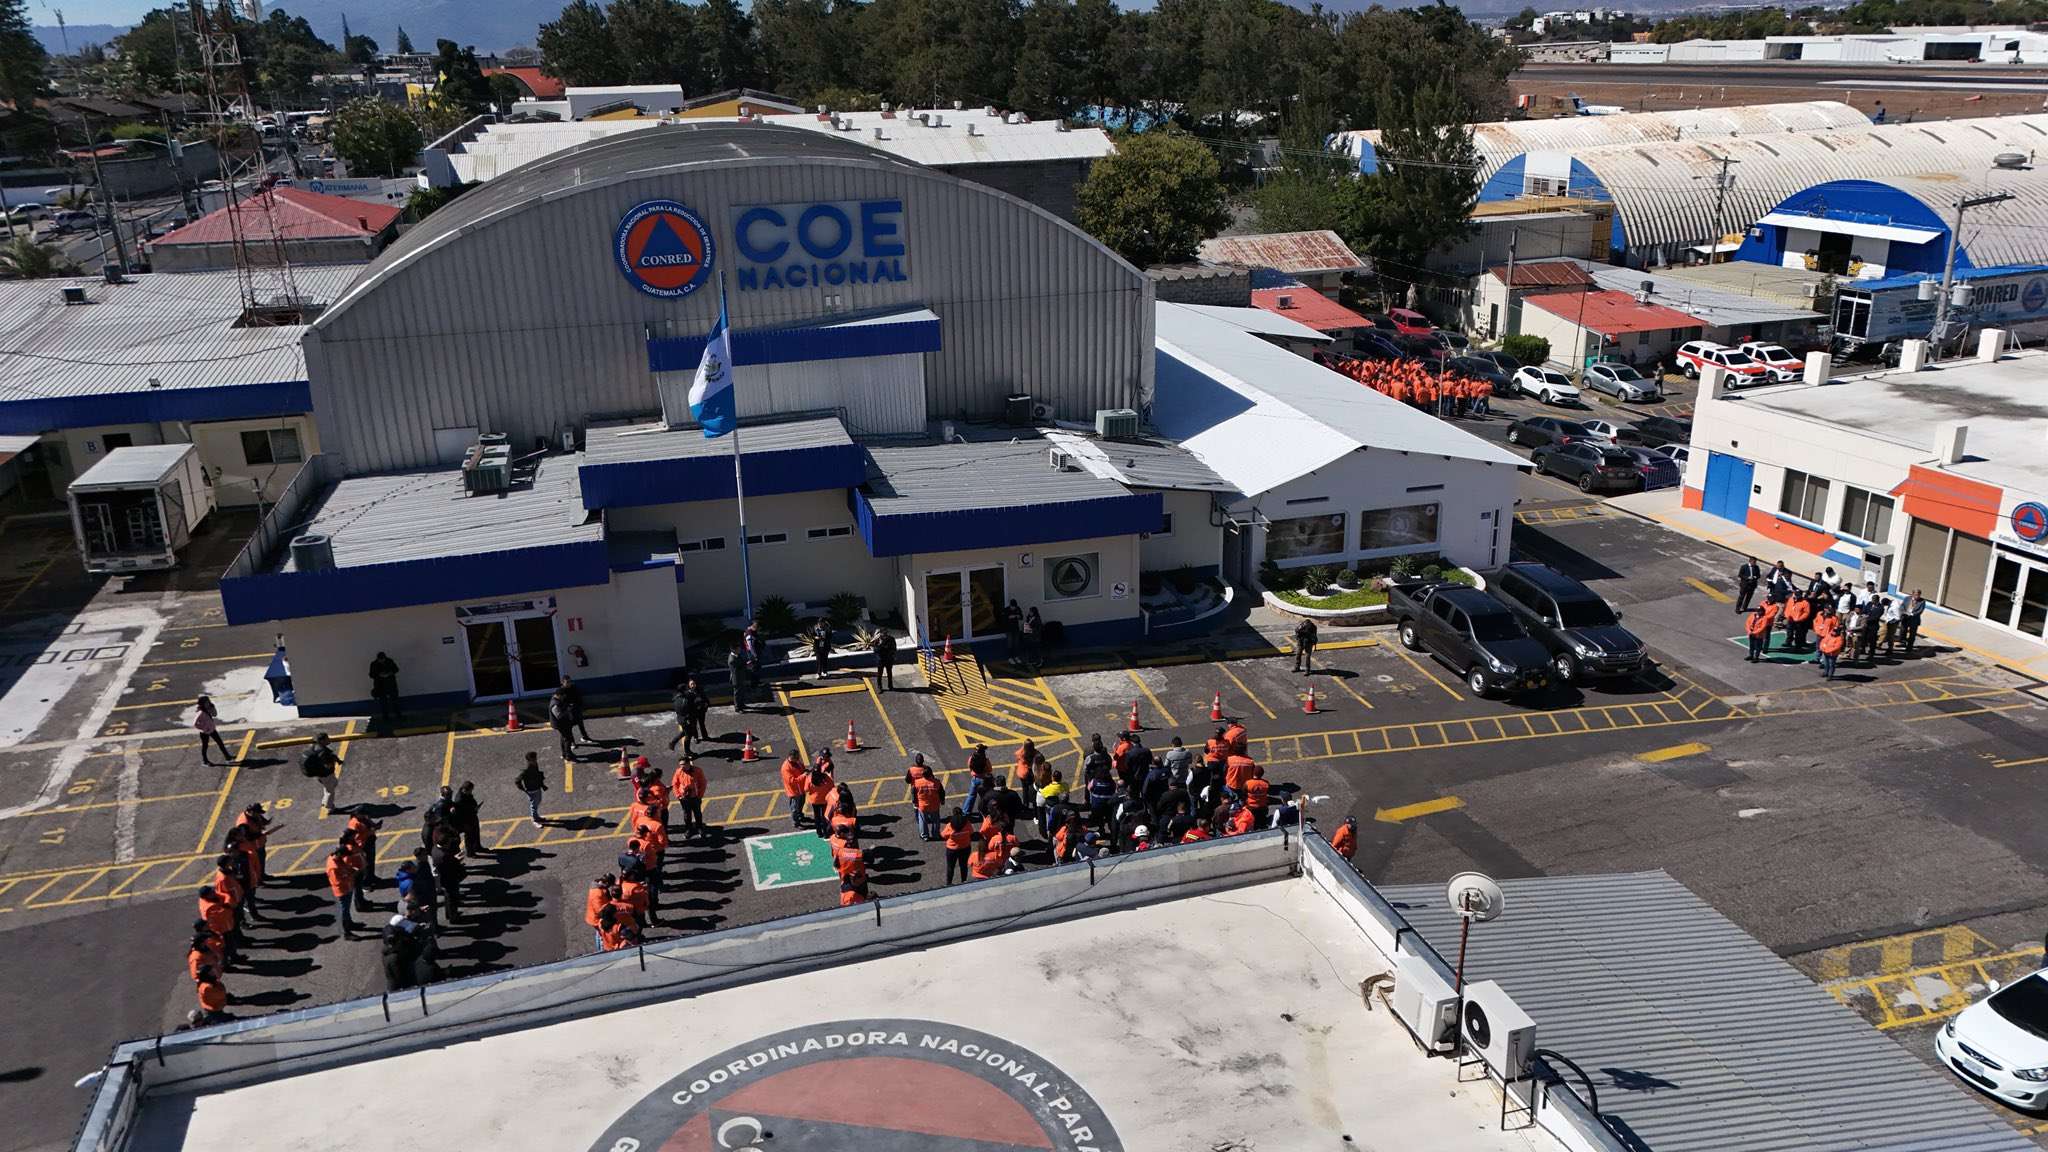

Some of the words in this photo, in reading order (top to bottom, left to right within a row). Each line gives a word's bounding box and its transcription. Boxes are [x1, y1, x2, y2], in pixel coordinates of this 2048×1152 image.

[625, 208, 649, 231] NACIONAL
[648, 205, 664, 213] PARA
[735, 200, 905, 263] COE
[641, 253, 692, 266] CONRED
[738, 258, 908, 291] NACIONAL
[146, 678, 170, 692] 14
[104, 720, 129, 736] 15
[67, 778, 96, 795] 16
[376, 784, 410, 799] 19
[260, 798, 293, 813] 18
[39, 827, 66, 845] 17
[671, 1030, 909, 1106] COORDINADORA
[919, 1033, 1051, 1098] NACIONAL
